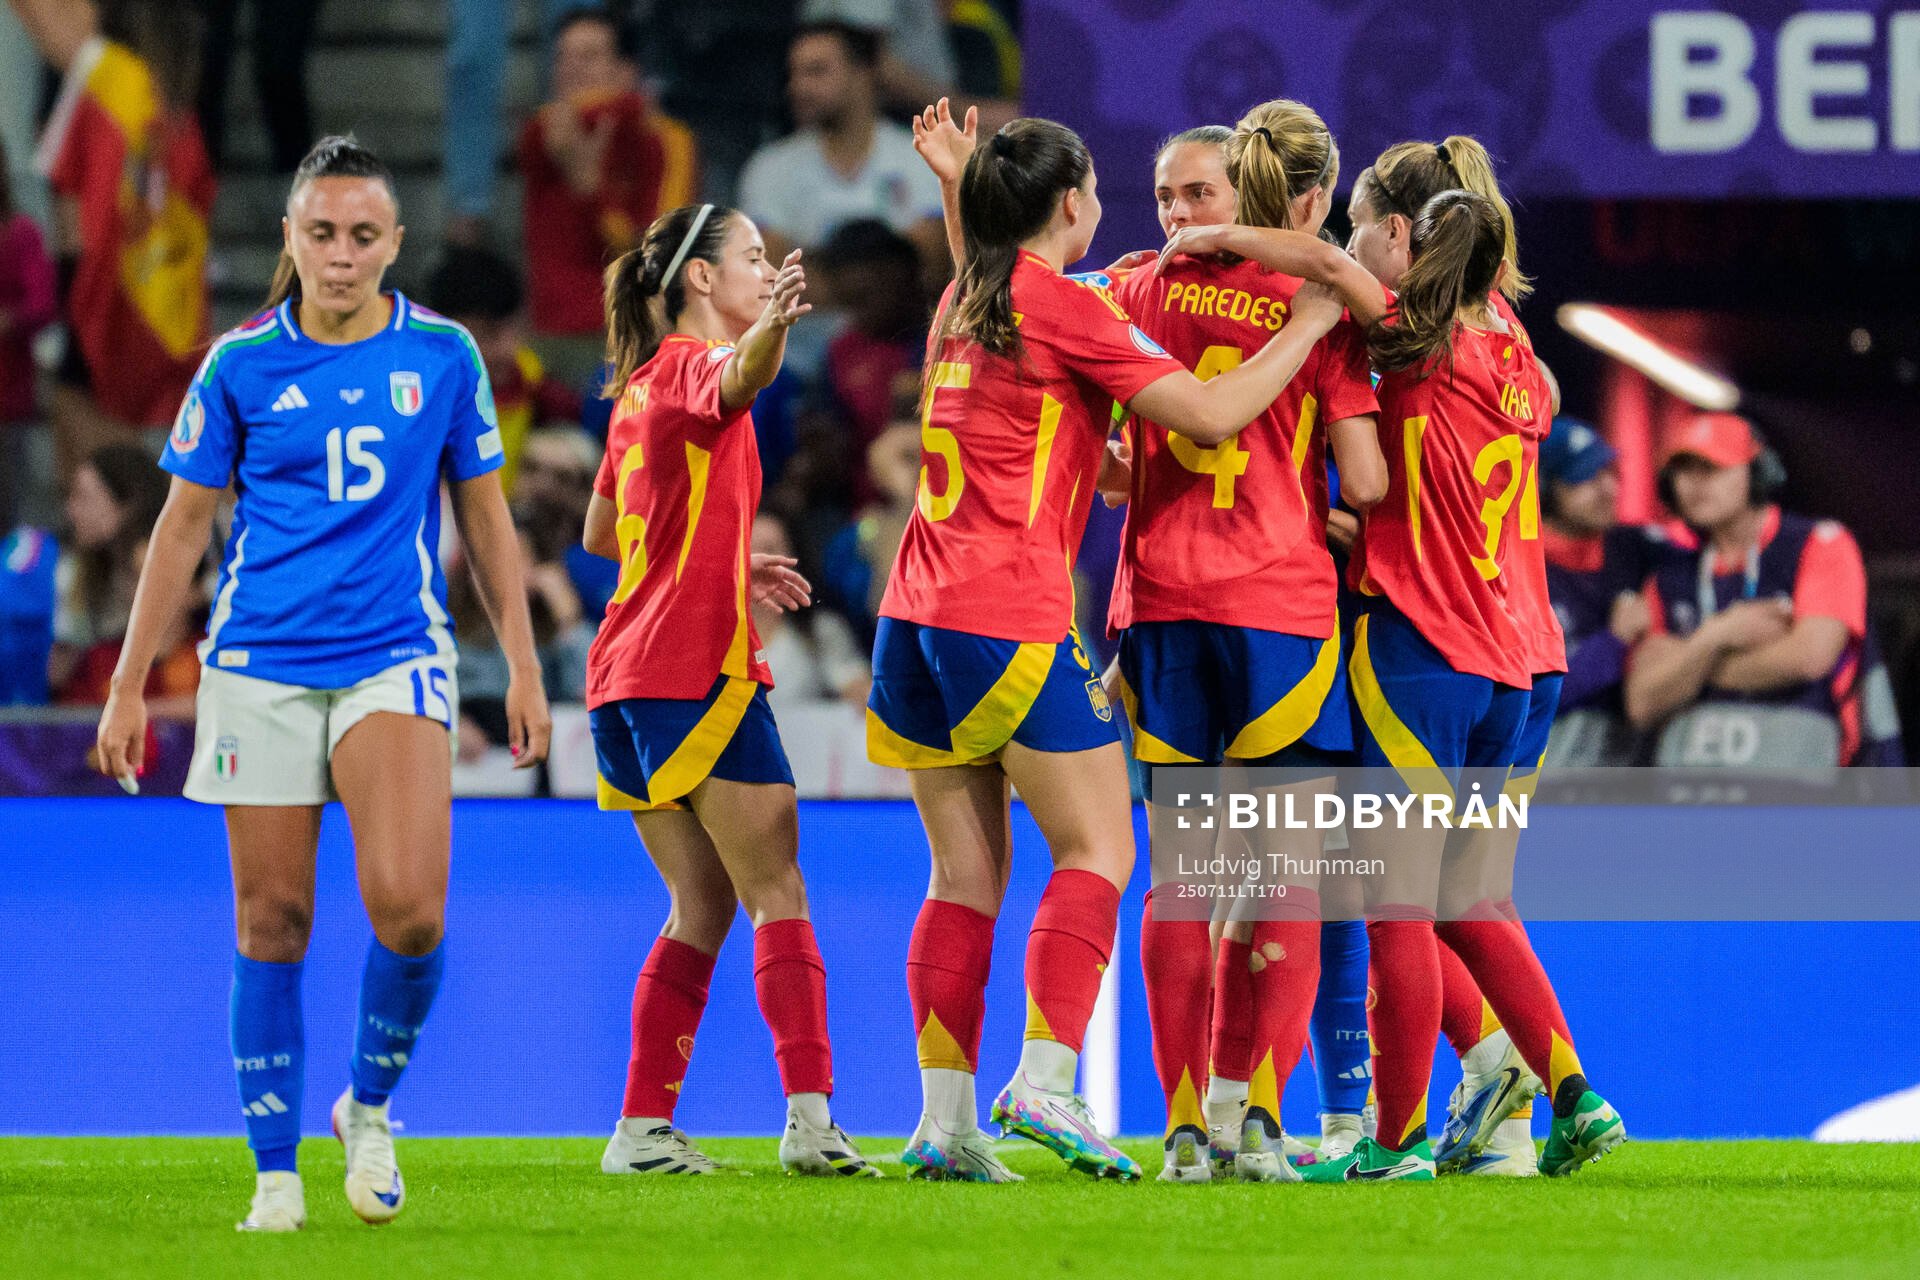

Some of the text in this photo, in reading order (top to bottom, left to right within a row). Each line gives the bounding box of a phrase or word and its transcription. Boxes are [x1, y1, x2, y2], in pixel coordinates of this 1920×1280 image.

[1164, 281, 1287, 331] PAREDES
[326, 424, 386, 502] 15
[918, 361, 972, 522] 5
[1167, 344, 1250, 509] 4
[612, 442, 647, 605] 6
[409, 666, 452, 731] 15
